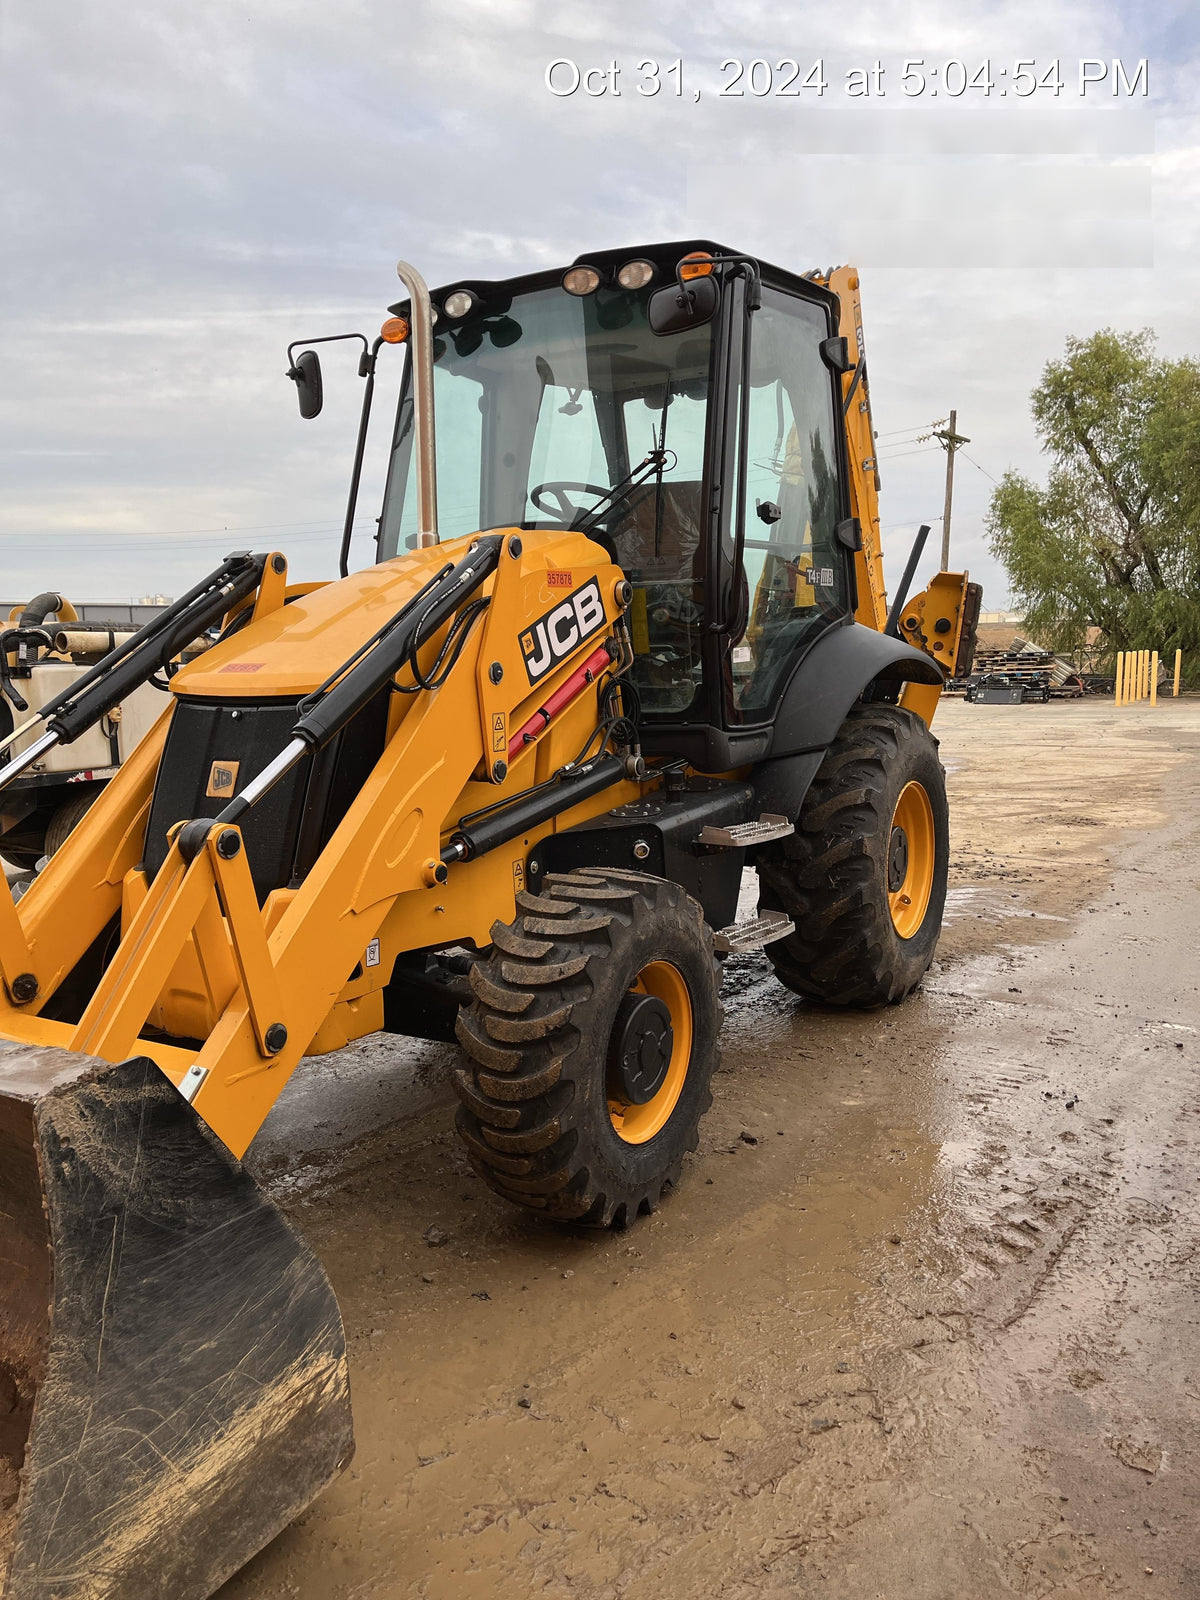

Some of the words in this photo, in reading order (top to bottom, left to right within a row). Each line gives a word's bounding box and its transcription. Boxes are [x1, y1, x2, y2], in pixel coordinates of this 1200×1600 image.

[547, 573, 572, 585] 357878
[527, 583, 604, 677] JCB
[214, 769, 232, 788] JCB
